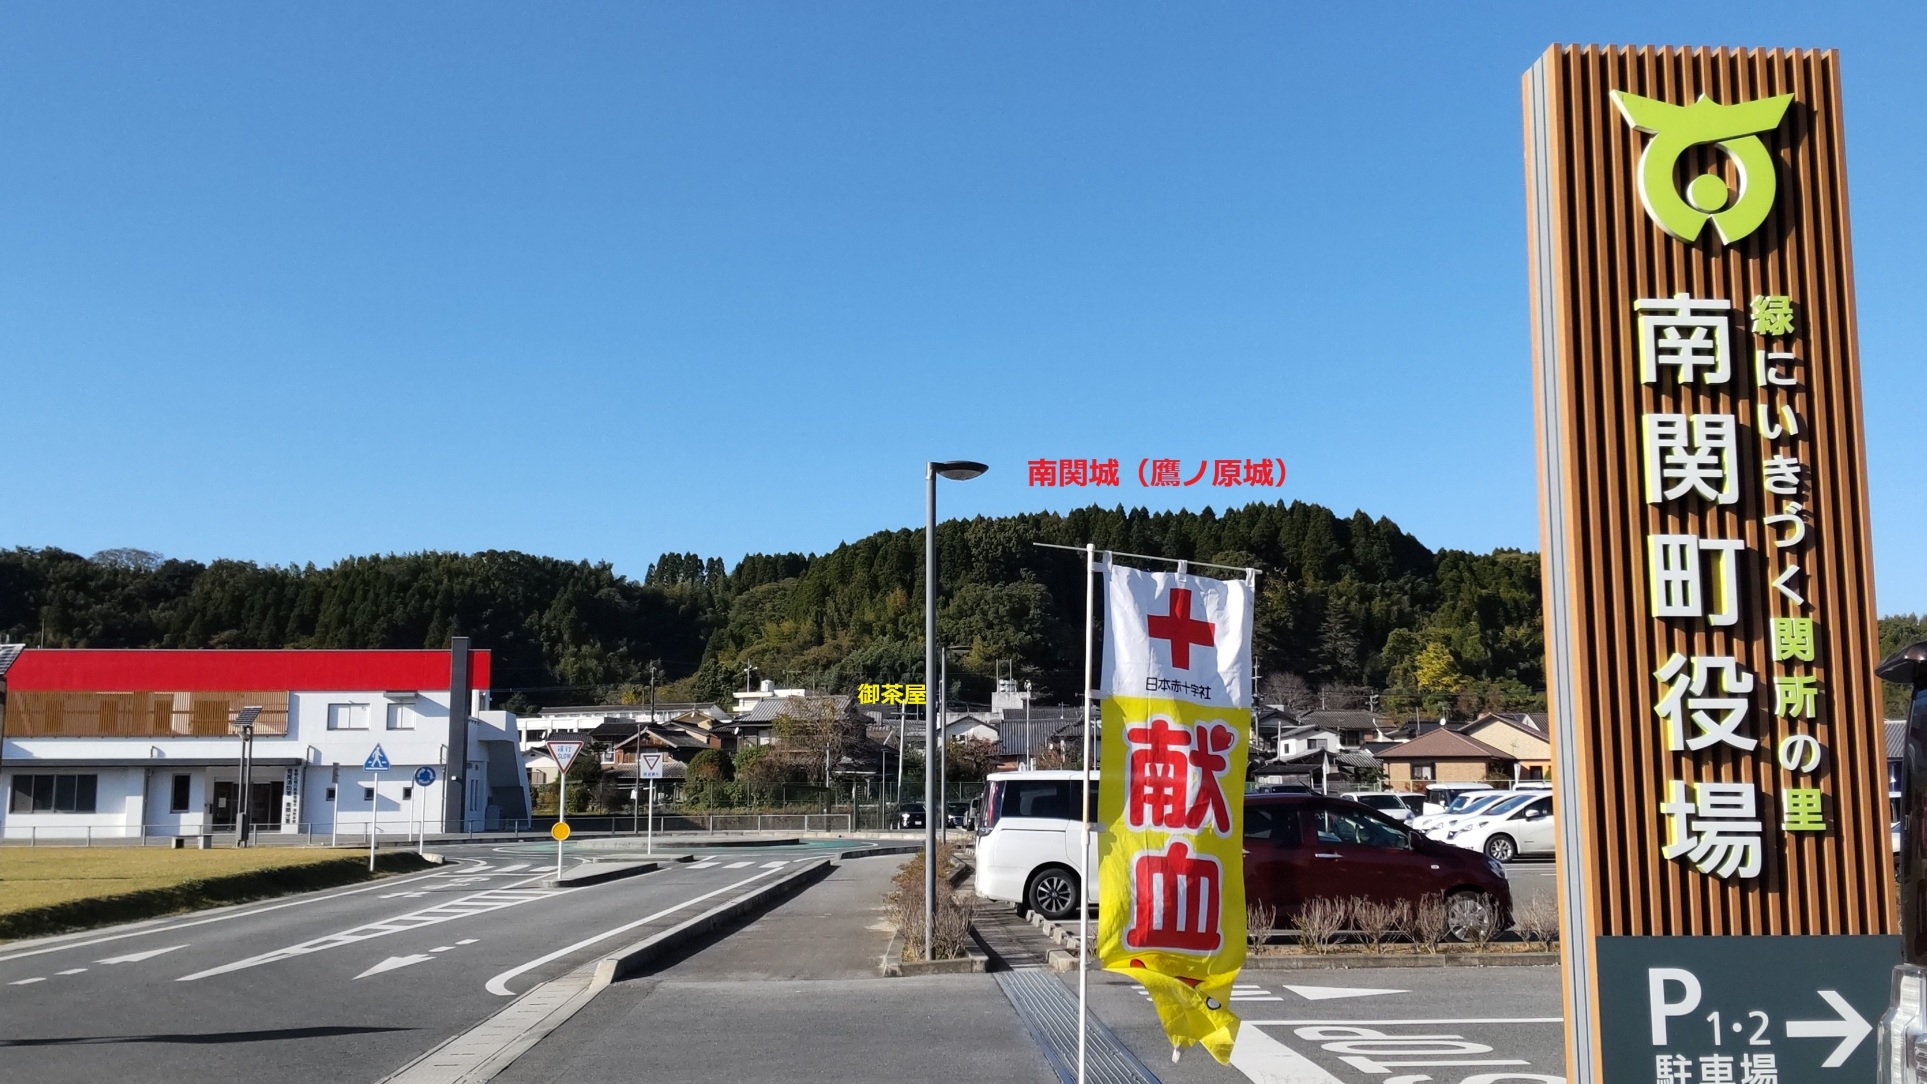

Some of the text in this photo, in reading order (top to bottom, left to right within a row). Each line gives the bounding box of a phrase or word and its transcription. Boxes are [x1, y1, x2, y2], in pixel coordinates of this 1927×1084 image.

[1633, 292, 1763, 879] 南関町役場
[1750, 294, 1827, 832] 緑にいきづく関所の里
[1146, 677, 1212, 700] 日本赤十字社
[1126, 717, 1234, 950] 献血
[1648, 967, 1702, 1046] P
[1655, 1053, 1779, 1084] 駐車場
